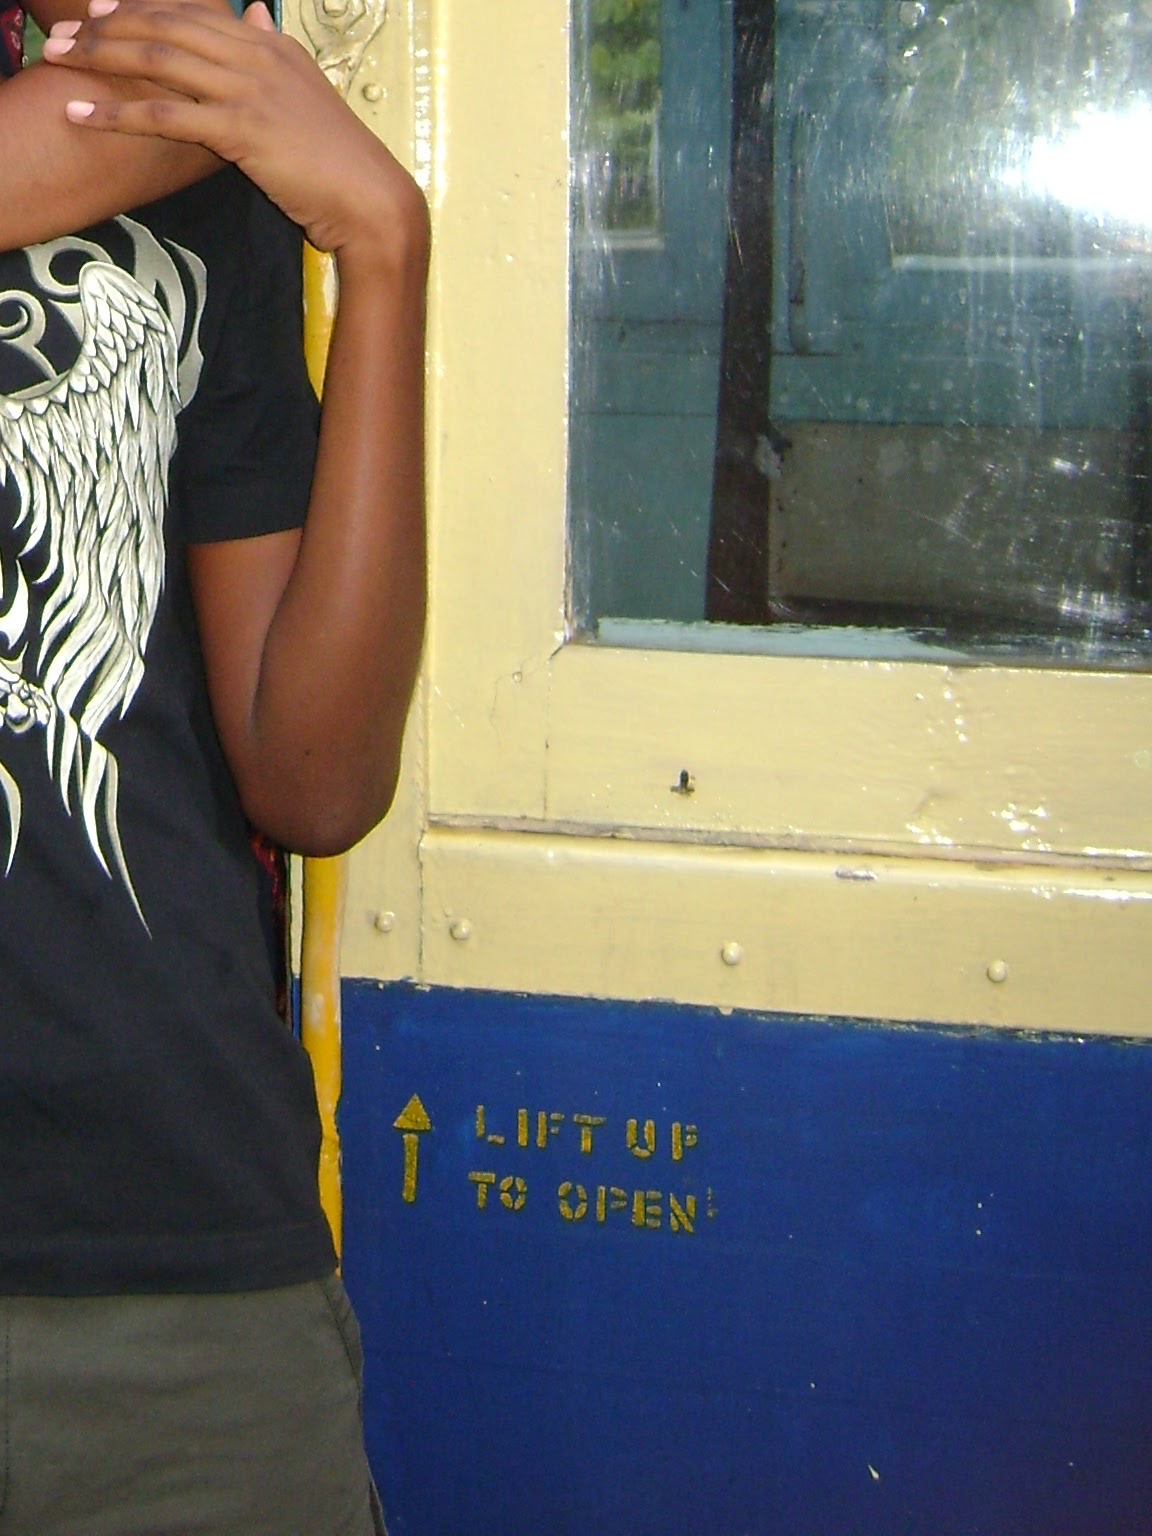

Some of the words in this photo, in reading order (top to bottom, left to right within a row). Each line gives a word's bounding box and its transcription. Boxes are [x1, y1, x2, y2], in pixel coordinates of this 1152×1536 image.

[474, 1104, 606, 1155] LIFT
[625, 1117, 698, 1162] UP
[468, 1171, 528, 1211] TO
